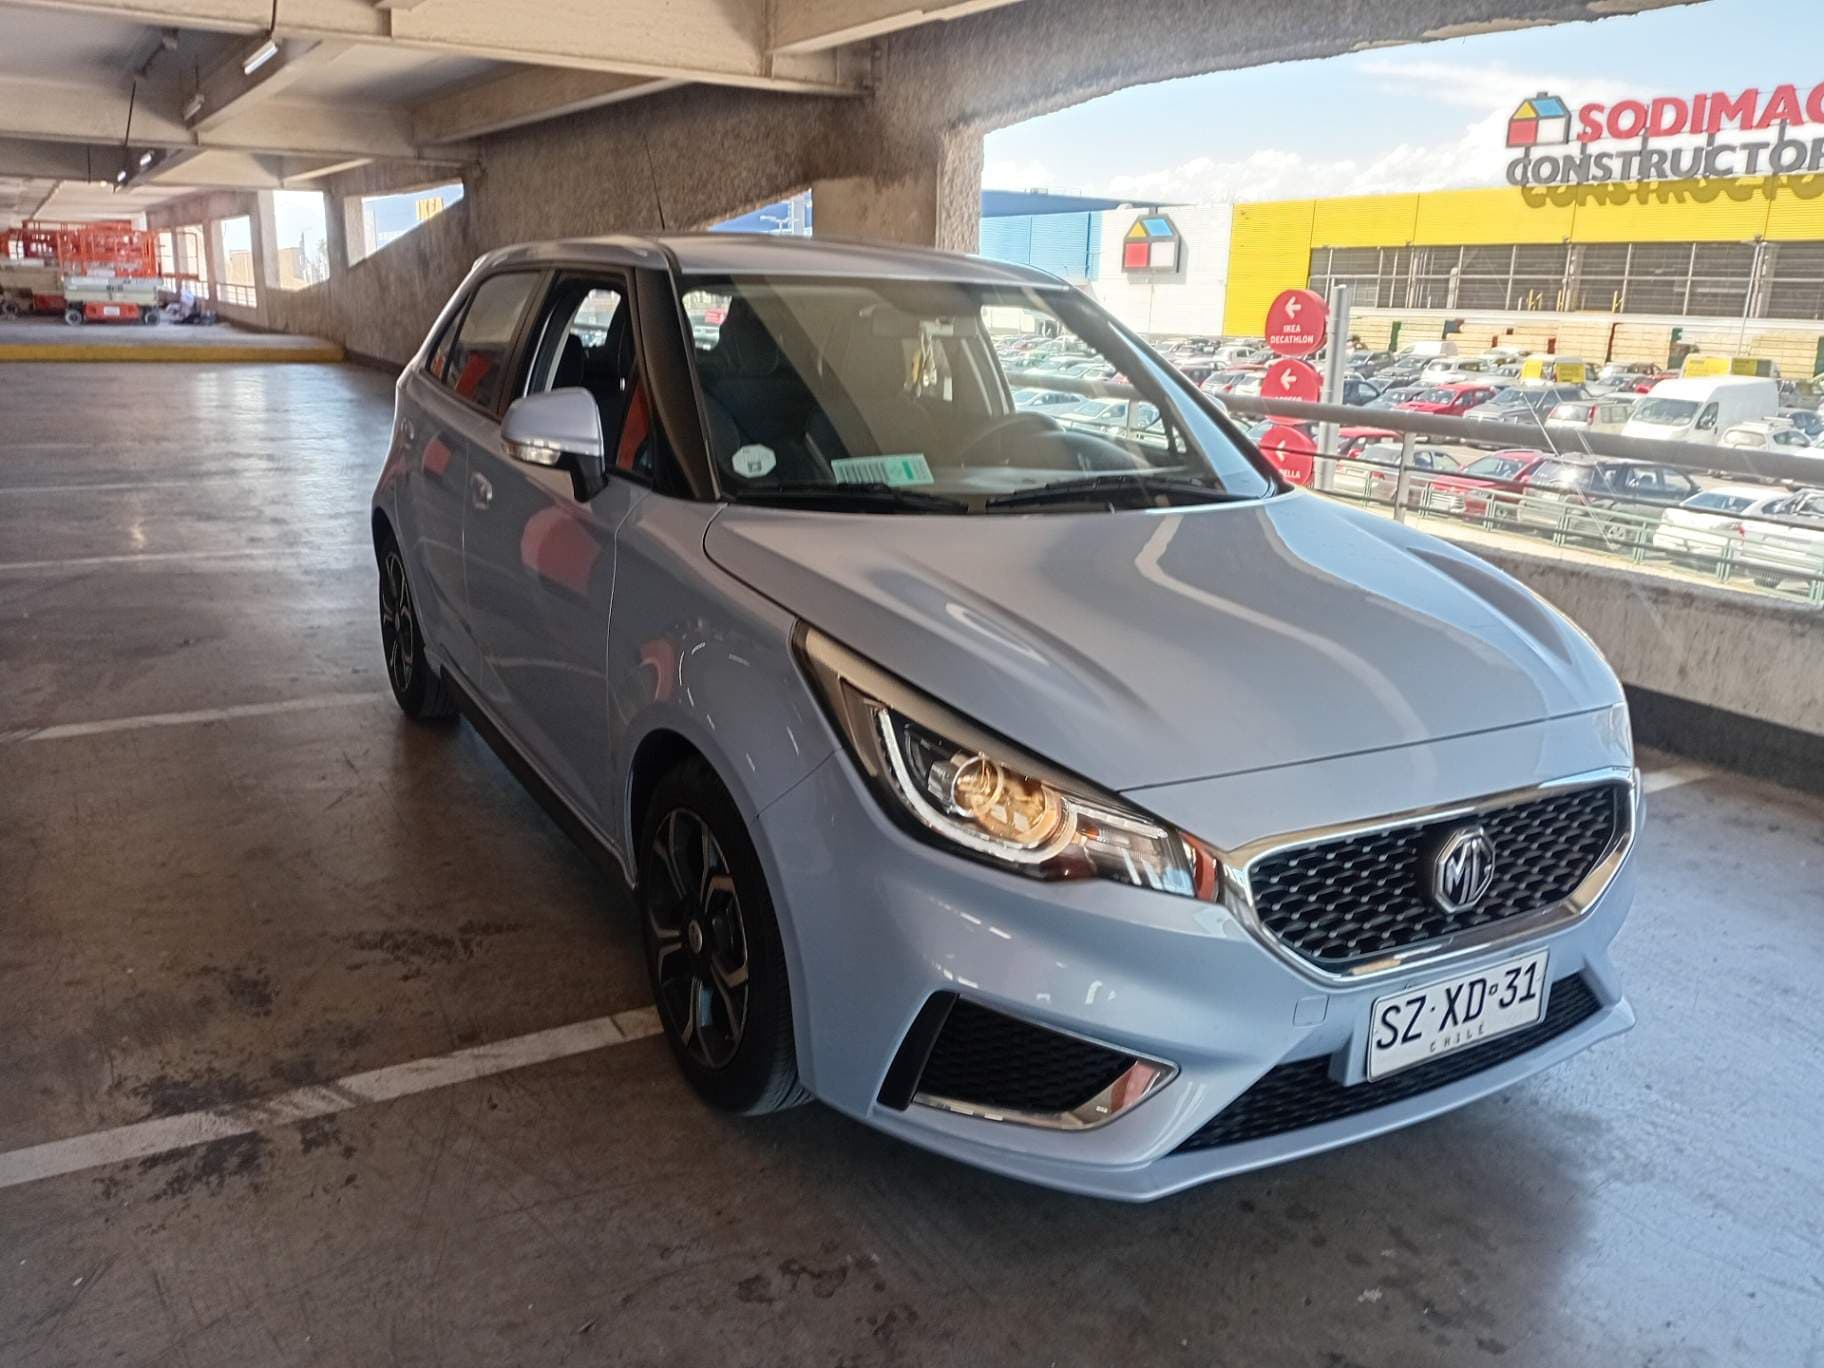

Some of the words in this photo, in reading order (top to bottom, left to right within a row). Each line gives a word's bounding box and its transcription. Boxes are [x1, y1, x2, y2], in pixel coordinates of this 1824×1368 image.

[1270, 334, 1314, 344] DECATHLON
[1283, 324, 1301, 333] IKEA
[1444, 837, 1493, 905] MG
[1429, 1021, 1485, 1053] CHILE
